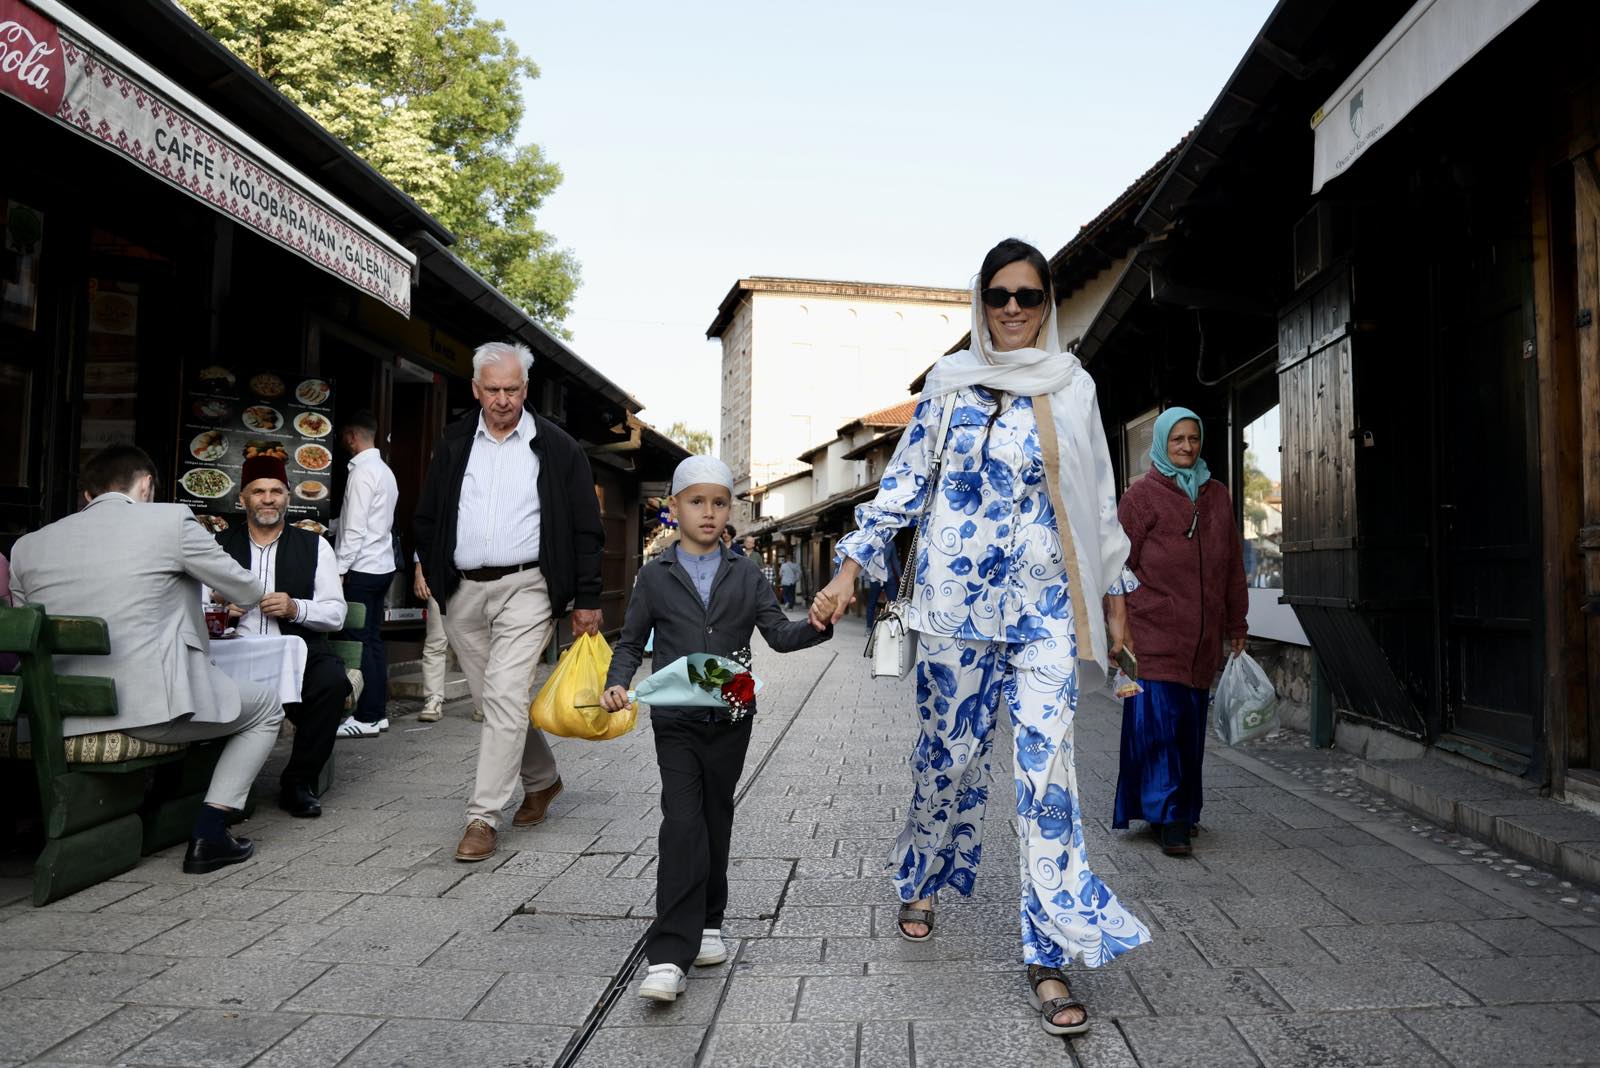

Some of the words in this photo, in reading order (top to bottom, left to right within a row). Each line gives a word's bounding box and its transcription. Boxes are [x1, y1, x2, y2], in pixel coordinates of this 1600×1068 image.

[155, 128, 214, 180] CAFFE
[230, 171, 308, 235] KOLOBARA
[310, 220, 335, 252] HAN
